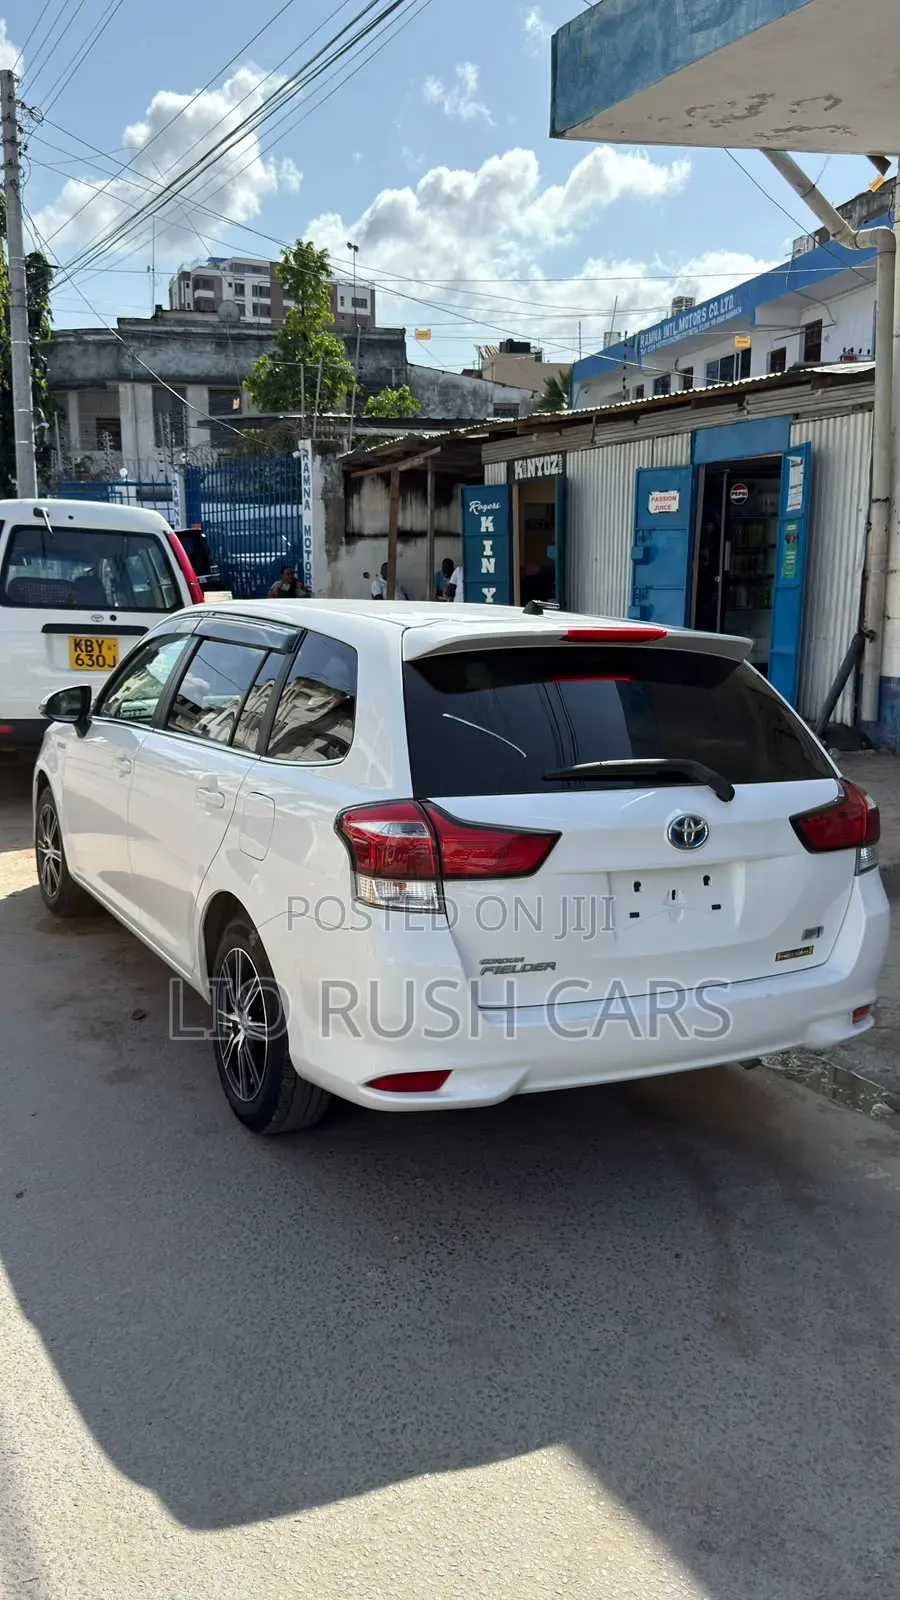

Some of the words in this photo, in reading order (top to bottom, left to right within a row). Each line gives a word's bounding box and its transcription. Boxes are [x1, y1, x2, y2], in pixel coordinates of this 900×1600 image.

[678, 307, 706, 332] MOTORS
[302, 449, 311, 511] RAMNA
[73, 638, 105, 654] KBY
[75, 653, 116, 668] 630J
[480, 961, 557, 976] FIELDER
